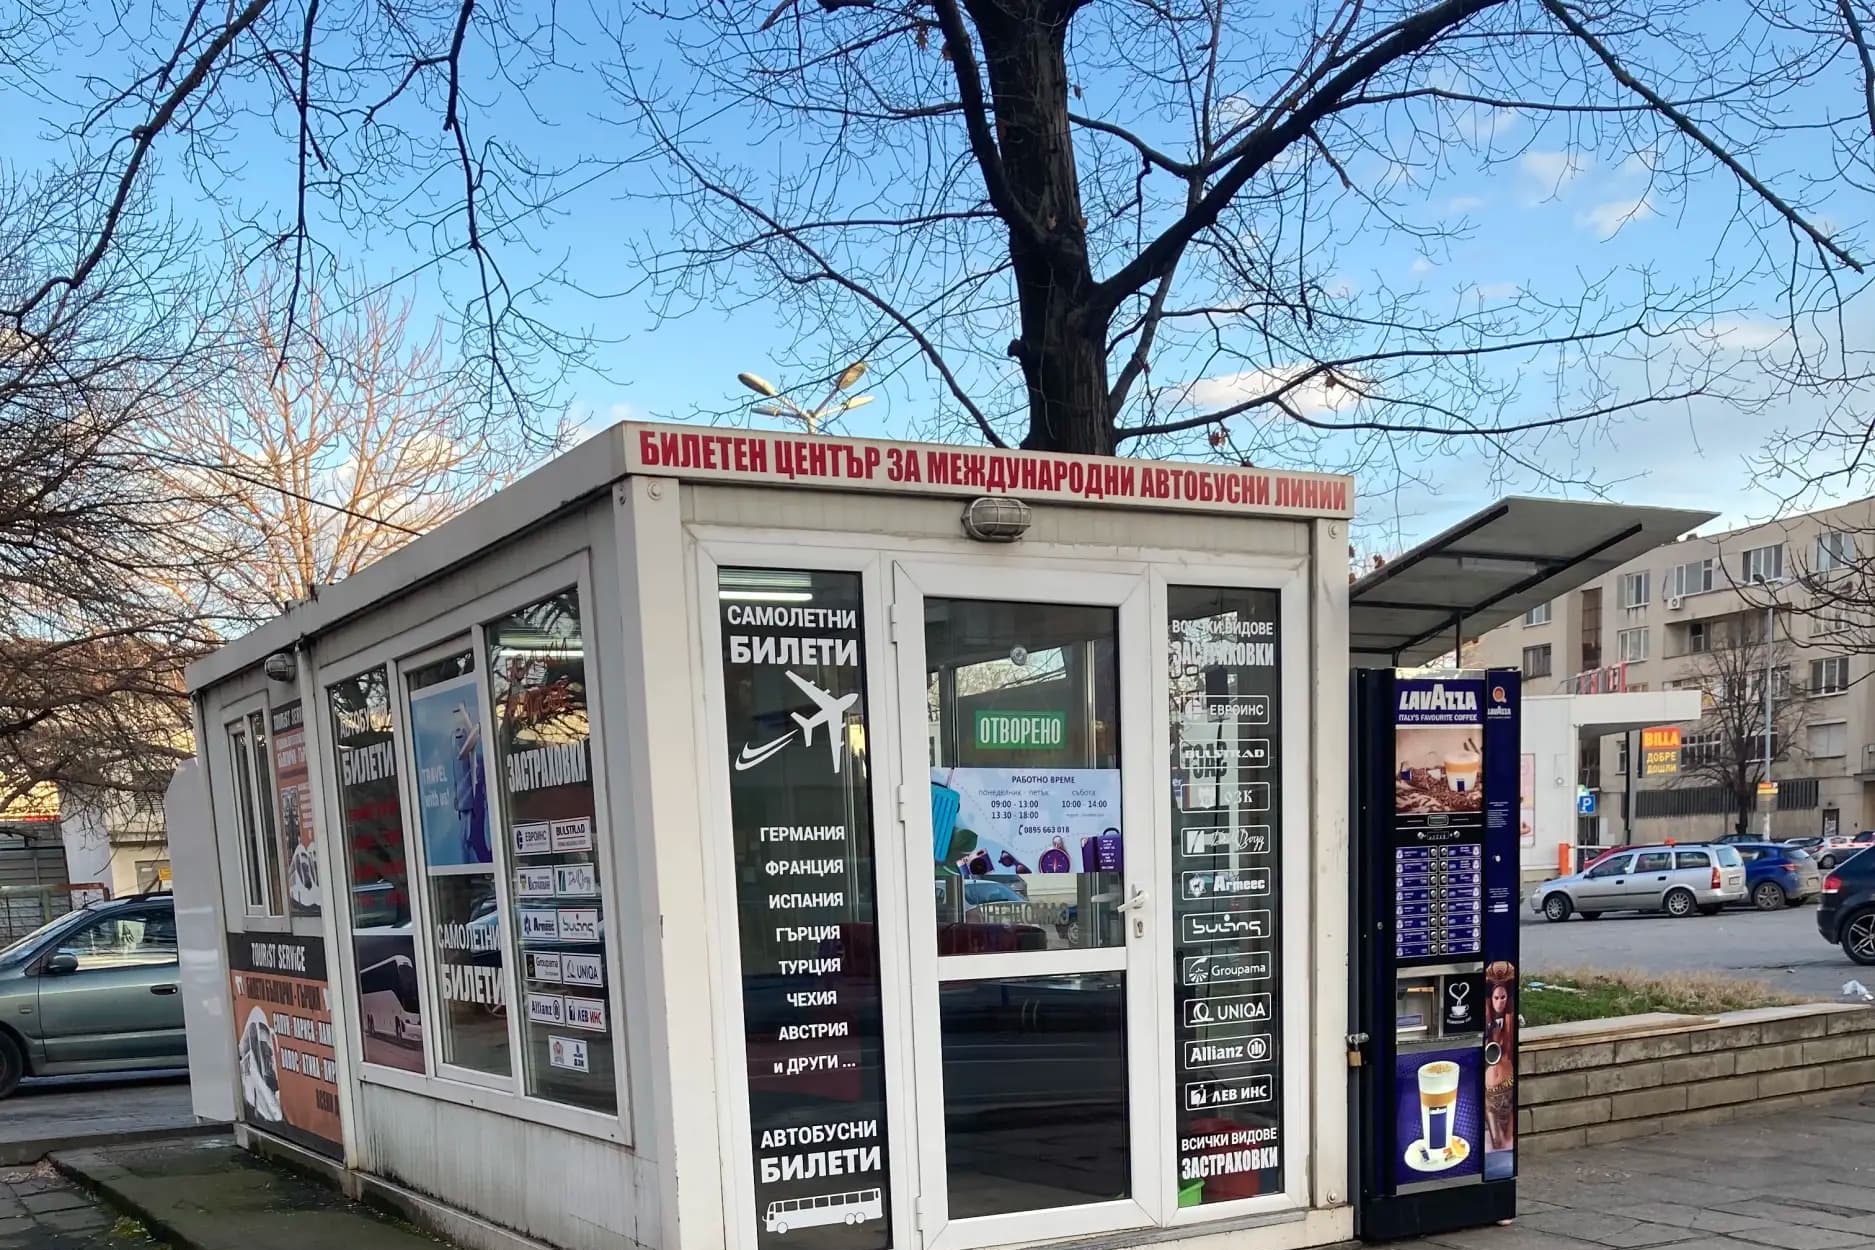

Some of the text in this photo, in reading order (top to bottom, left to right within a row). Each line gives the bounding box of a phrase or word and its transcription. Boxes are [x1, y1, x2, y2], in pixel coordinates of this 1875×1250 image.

[639, 430, 1346, 511] БИЛЕТЕН ЦЕНТЪР ЗА МЕЖДУНАРОДНИ АВТОБУСНИ ЛИНИИ
[727, 605, 857, 629] САМОЛЕТНИ
[729, 635, 858, 667] БИЛЕТИ
[1399, 683, 1478, 711] LAVAZZA
[1210, 705, 1264, 716] ЕВРОИНС
[980, 717, 1061, 745] ОТВОРЕНО
[1644, 732, 1679, 747] BILLA
[342, 740, 395, 786] БИЛЕТИ
[1647, 752, 1677, 763] ДОБРЕ
[506, 741, 587, 793] ЗАСТРАХОВКИ
[1011, 776, 1075, 784] РАБОТНО ВРЕМЕ
[1019, 800, 1039, 808] 13:00
[1061, 800, 1082, 808] 10:00
[1088, 800, 1108, 808] 14:00
[1019, 811, 1039, 819] 18:00
[760, 826, 845, 843] ГЕРМАНИЯ
[765, 859, 844, 877] ФРАНЦИЯ
[1213, 875, 1266, 893] Armeec
[768, 892, 844, 909] ИСПАНИЯ
[437, 922, 501, 951] САМОЛЕТНИ
[776, 925, 841, 943] ГЪРЦИЯ
[576, 965, 599, 980] UNIQA
[779, 958, 841, 976] ТУРЦИЯ
[1211, 963, 1266, 978] Groupama
[440, 963, 507, 1006] БИЛЕТИ
[531, 1000, 553, 1016] Allianz
[786, 990, 837, 1008] ЧЕХИЯ
[1217, 1002, 1266, 1020] UNIQA
[778, 1021, 849, 1040] АВСТРИЯ
[1190, 1044, 1243, 1063] Allianz
[773, 1061, 783, 1074] и
[786, 1055, 838, 1076] ДРУГИ
[1212, 1084, 1267, 1103] ЛЕВ ИНС
[760, 1119, 877, 1149] АВТОБУСНИ
[1181, 1127, 1277, 1152] ВСИЧКИ ВИДОВЕ
[760, 1146, 882, 1184] БИЛЕТИ
[1181, 1146, 1278, 1181] ЗАСТРАХОВКИ
